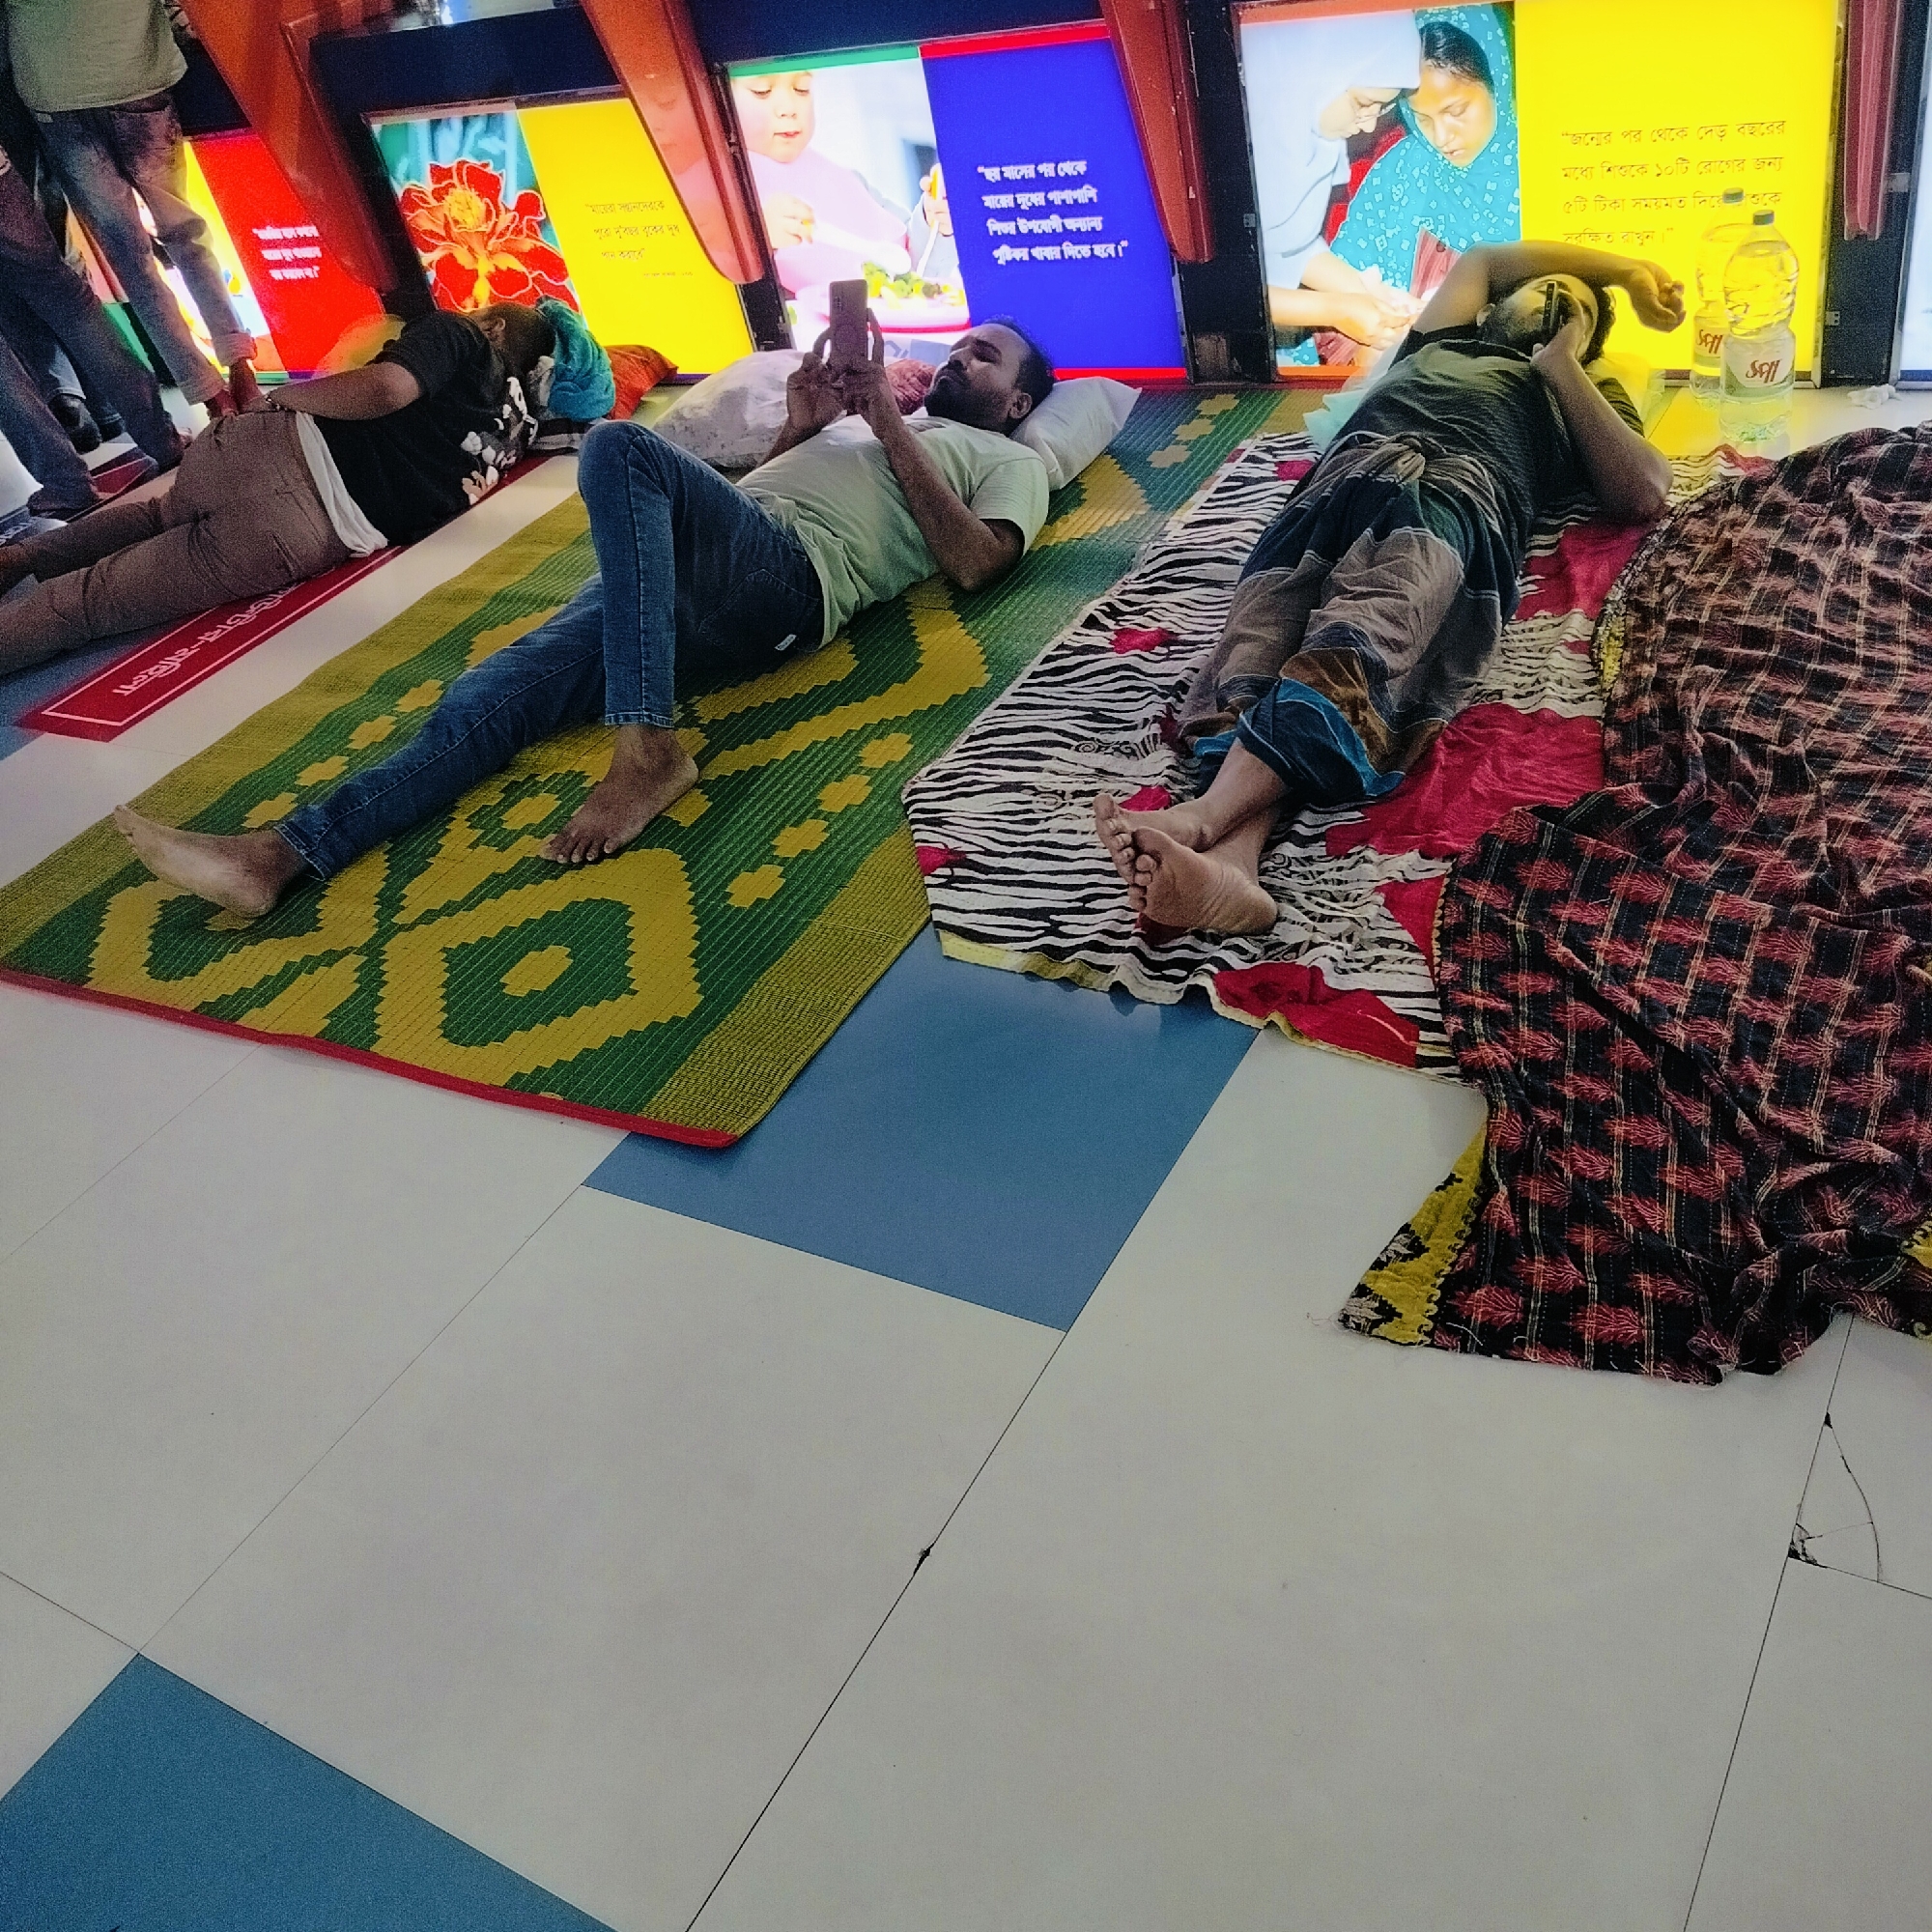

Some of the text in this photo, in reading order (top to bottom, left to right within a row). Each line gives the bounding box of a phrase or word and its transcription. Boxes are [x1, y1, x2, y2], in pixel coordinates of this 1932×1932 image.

[1561, 120, 1786, 147] “জন্মের পর থেকে দেড় বছরের
[1561, 156, 1785, 181] মধ্যে শিশুকে ১০টি রোগের জন্য
[1562, 195, 1588, 213] ৫টি
[1593, 194, 1626, 213] টিকা
[1631, 196, 1688, 211] সময়মত
